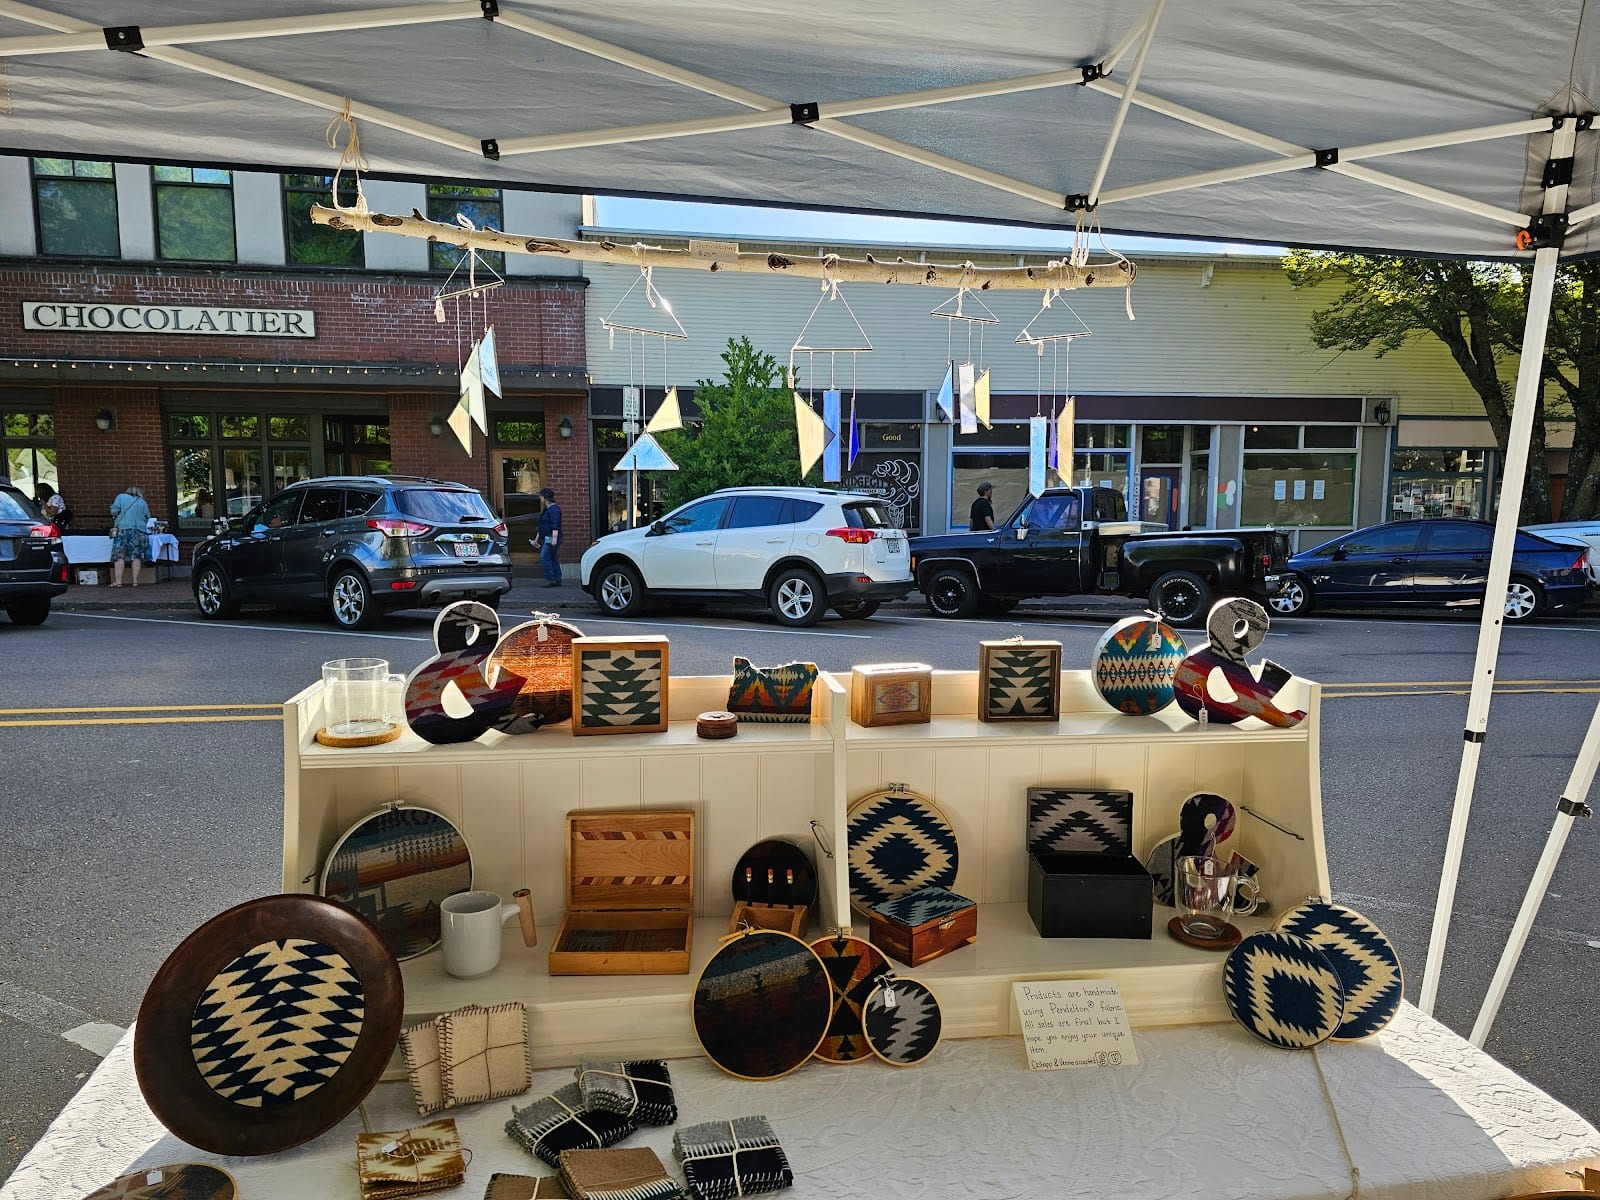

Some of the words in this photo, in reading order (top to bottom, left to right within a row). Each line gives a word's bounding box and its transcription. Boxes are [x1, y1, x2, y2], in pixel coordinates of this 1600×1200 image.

[32, 304, 307, 335] CHOCOLATIER
[882, 433, 901, 441] Good
[1023, 986, 1062, 1000] Products
[1067, 991, 1081, 999] are
[1082, 987, 1119, 997] handmade
[1022, 1008, 1044, 1017] using
[1024, 1020, 1034, 1030] All
[1037, 1019, 1054, 1028] sales
[1075, 1017, 1093, 1026] final
[1097, 1017, 1111, 1026] but
[1114, 1016, 1121, 1025] I
[1026, 1034, 1042, 1043] hope
[1046, 1034, 1058, 1044] you
[1061, 1033, 1079, 1043] enjoy
[1081, 1032, 1097, 1043] your
[1102, 1031, 1125, 1041] unique
[1053, 1058, 1059, 1067] &
